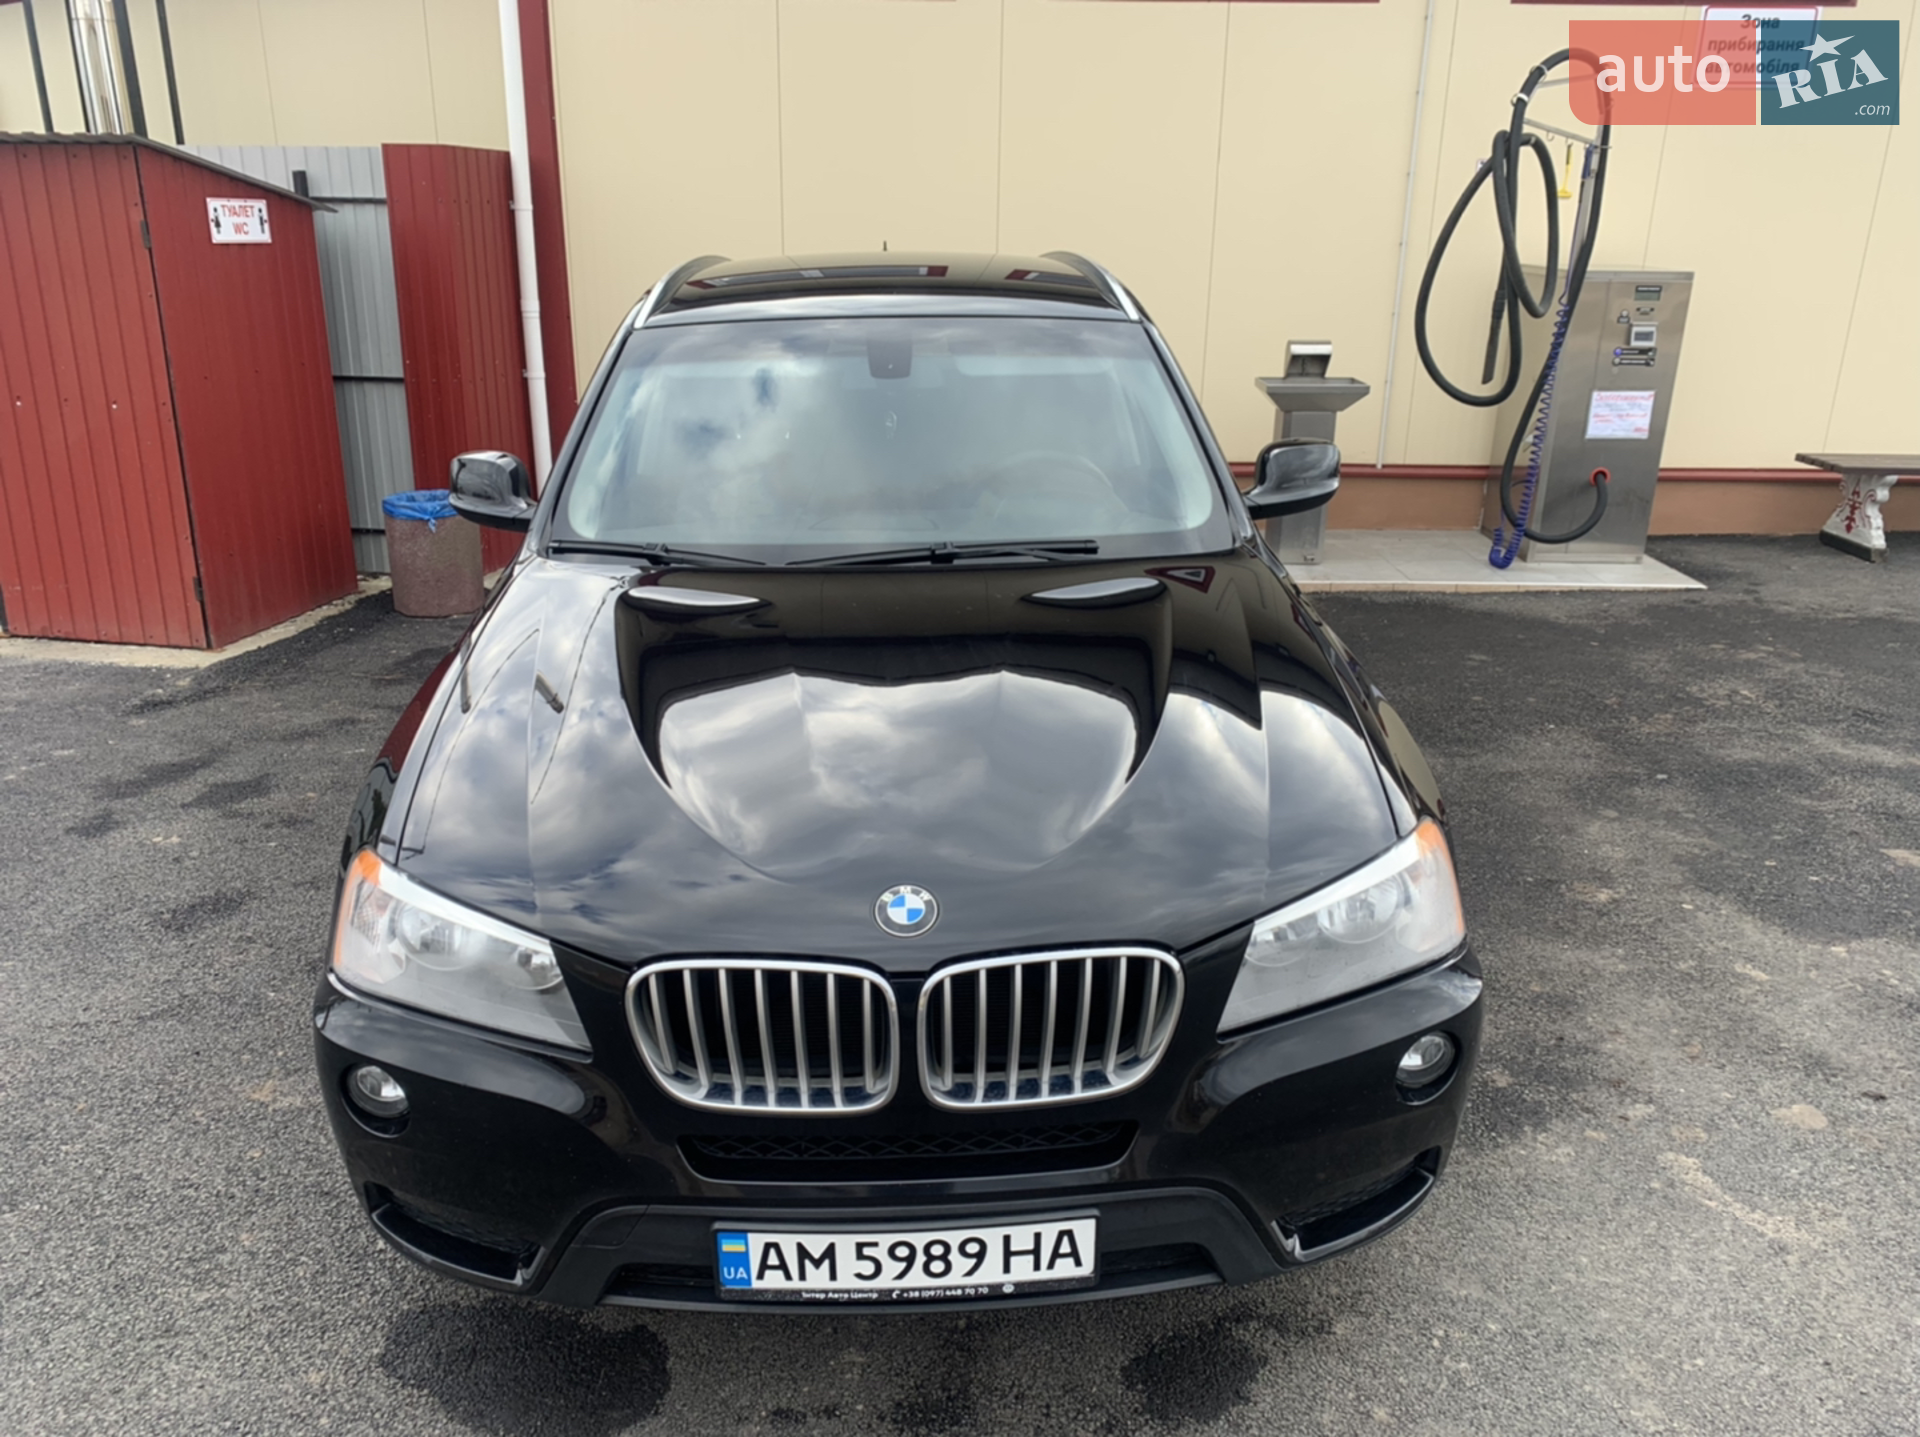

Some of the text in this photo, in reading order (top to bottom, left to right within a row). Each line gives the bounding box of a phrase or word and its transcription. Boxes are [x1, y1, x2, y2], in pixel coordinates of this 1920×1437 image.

[1740, 14, 1780, 29] Зона
[1707, 35, 1805, 55] прибирання
[220, 204, 255, 218] ТУАЛЕТ
[232, 222, 249, 235] WC
[880, 886, 933, 903] BMW
[755, 1228, 1084, 1282] AM 5989 HA
[723, 1266, 749, 1281] UA
[963, 1286, 976, 1296] 70
[976, 1285, 990, 1295] 70
